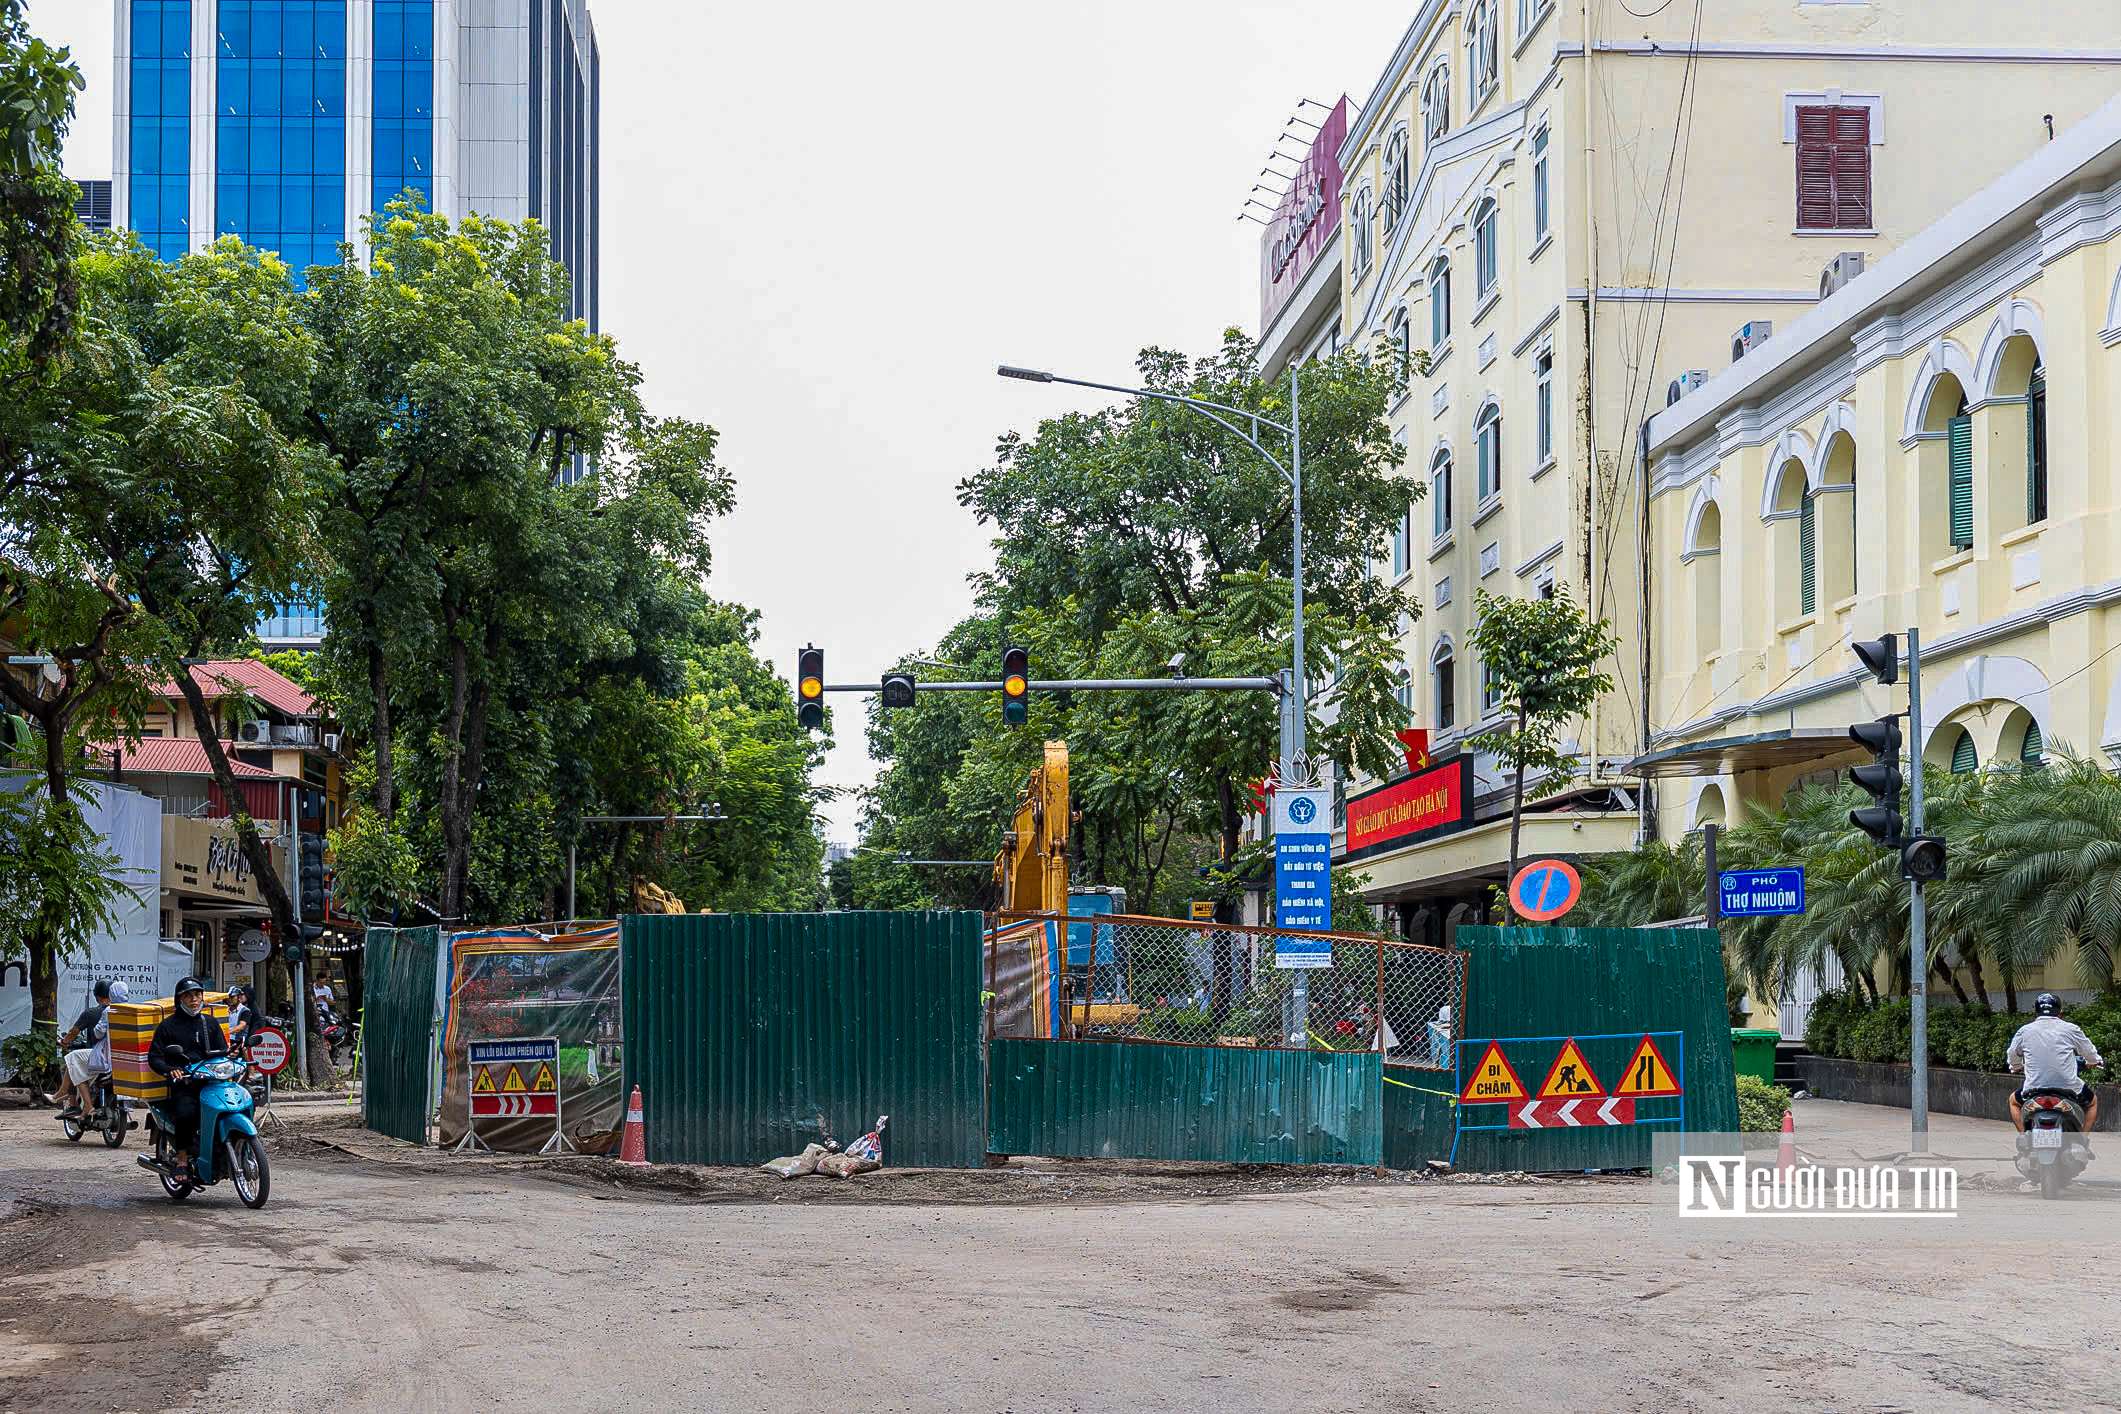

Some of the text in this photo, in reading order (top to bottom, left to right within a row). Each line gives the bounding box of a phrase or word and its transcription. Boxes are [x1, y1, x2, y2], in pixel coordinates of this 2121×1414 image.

[1364, 809, 1376, 833] GIÁO
[1752, 873, 1778, 885] PHỐ
[1726, 888, 1796, 912] THỢ NHUỘM
[105, 964, 134, 972] ĐANG
[137, 965, 154, 973] THI
[128, 974, 151, 984] TIỆN
[476, 1047, 485, 1057] XIN
[1488, 1064, 1500, 1076] ĐI
[1477, 1080, 1510, 1096] CHẬM
